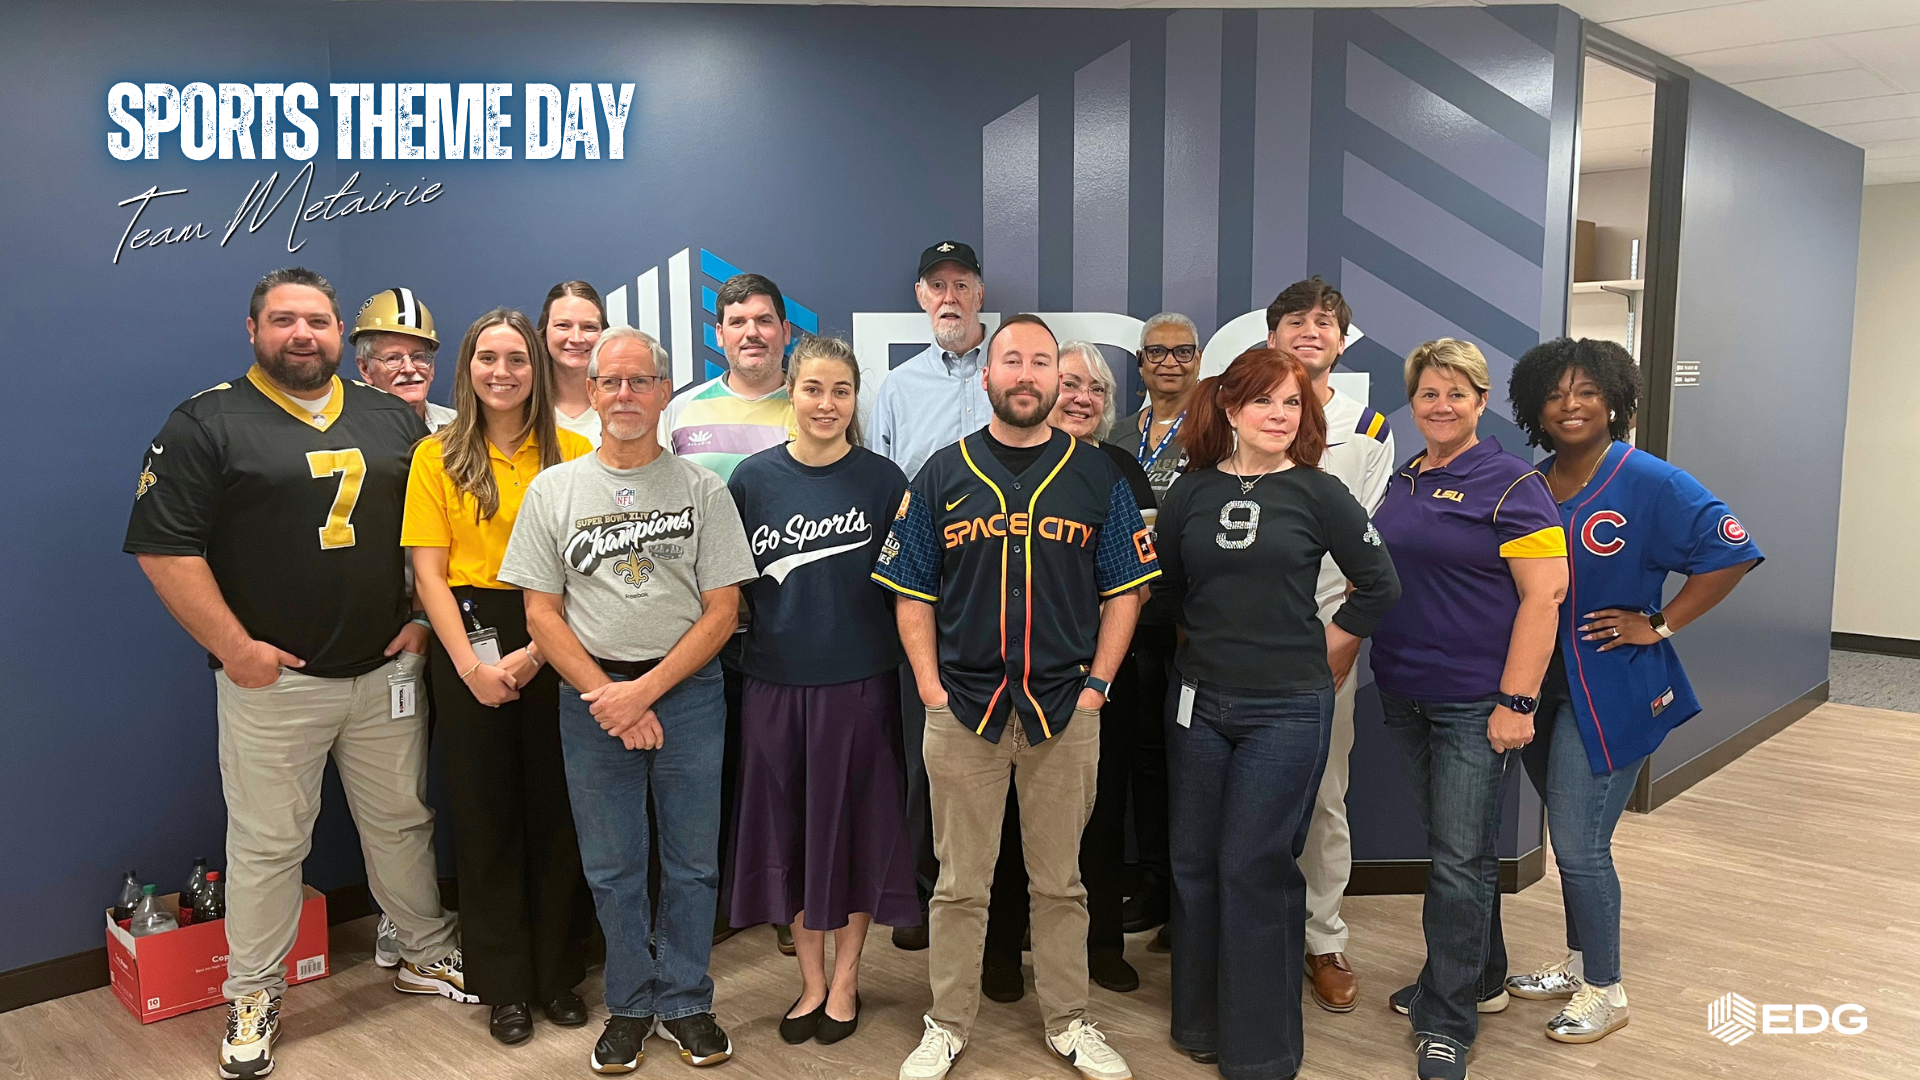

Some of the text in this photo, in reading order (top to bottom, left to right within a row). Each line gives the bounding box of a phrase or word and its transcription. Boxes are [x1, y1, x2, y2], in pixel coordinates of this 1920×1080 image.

[305, 447, 367, 550] 7
[617, 496, 633, 506] NFL
[1432, 488, 1465, 503] LSU
[576, 511, 651, 528] SUPER BOWL XLIV
[752, 506, 868, 556] Go Sports
[943, 512, 1093, 549] SPACE CITY
[1216, 500, 1261, 549] 9
[1580, 510, 1627, 556] C
[563, 507, 692, 574] Champions
[211, 954, 230, 963] Cop
[149, 998, 159, 1007] 10
